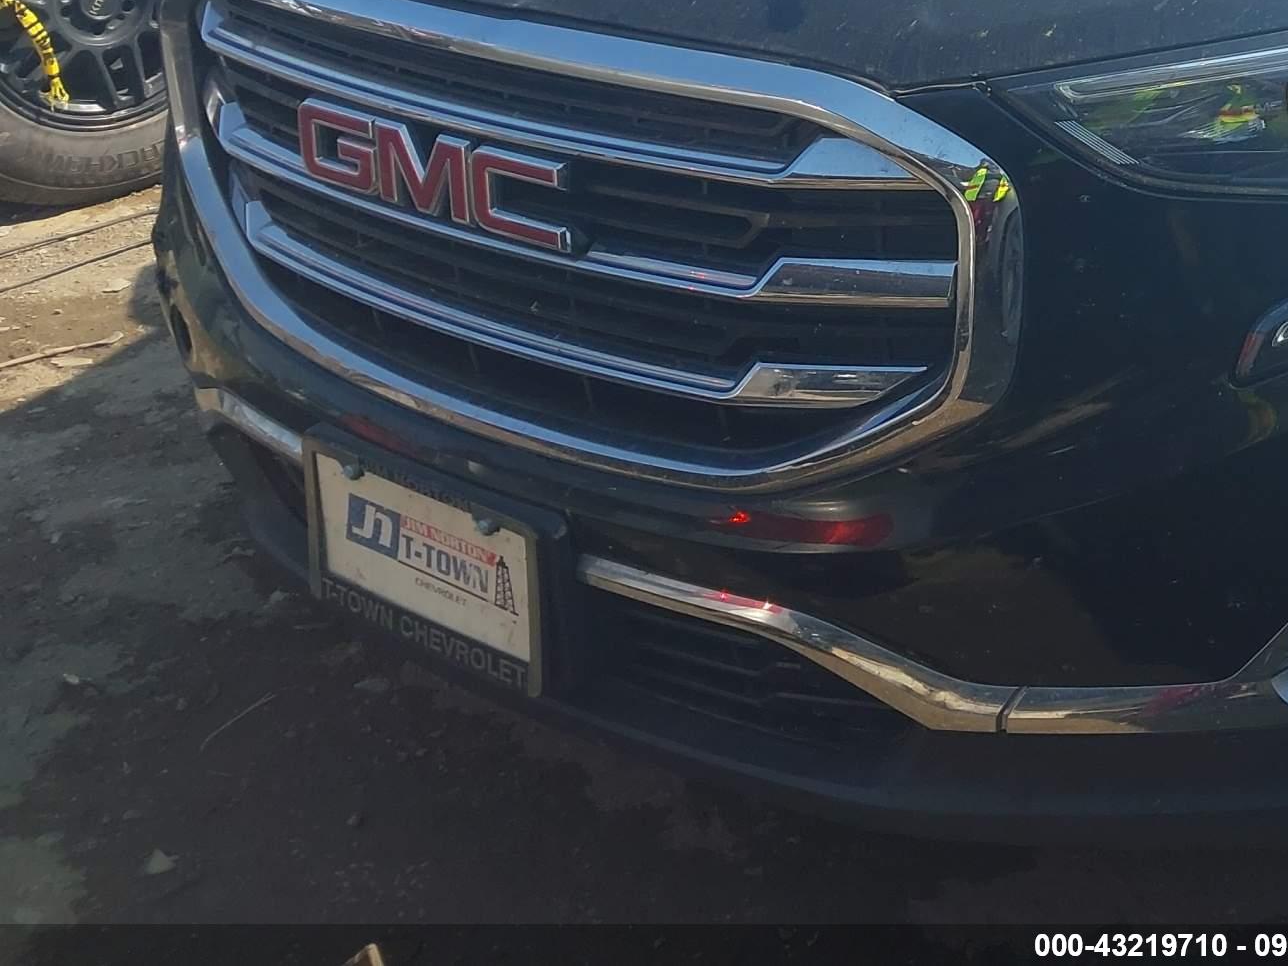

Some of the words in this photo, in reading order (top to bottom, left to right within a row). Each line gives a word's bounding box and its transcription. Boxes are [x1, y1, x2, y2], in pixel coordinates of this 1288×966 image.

[297, 98, 571, 252] GMC
[401, 533, 489, 594] T-TOWN
[321, 577, 394, 631] T-TOWN
[400, 615, 526, 690] CHEVROLET
